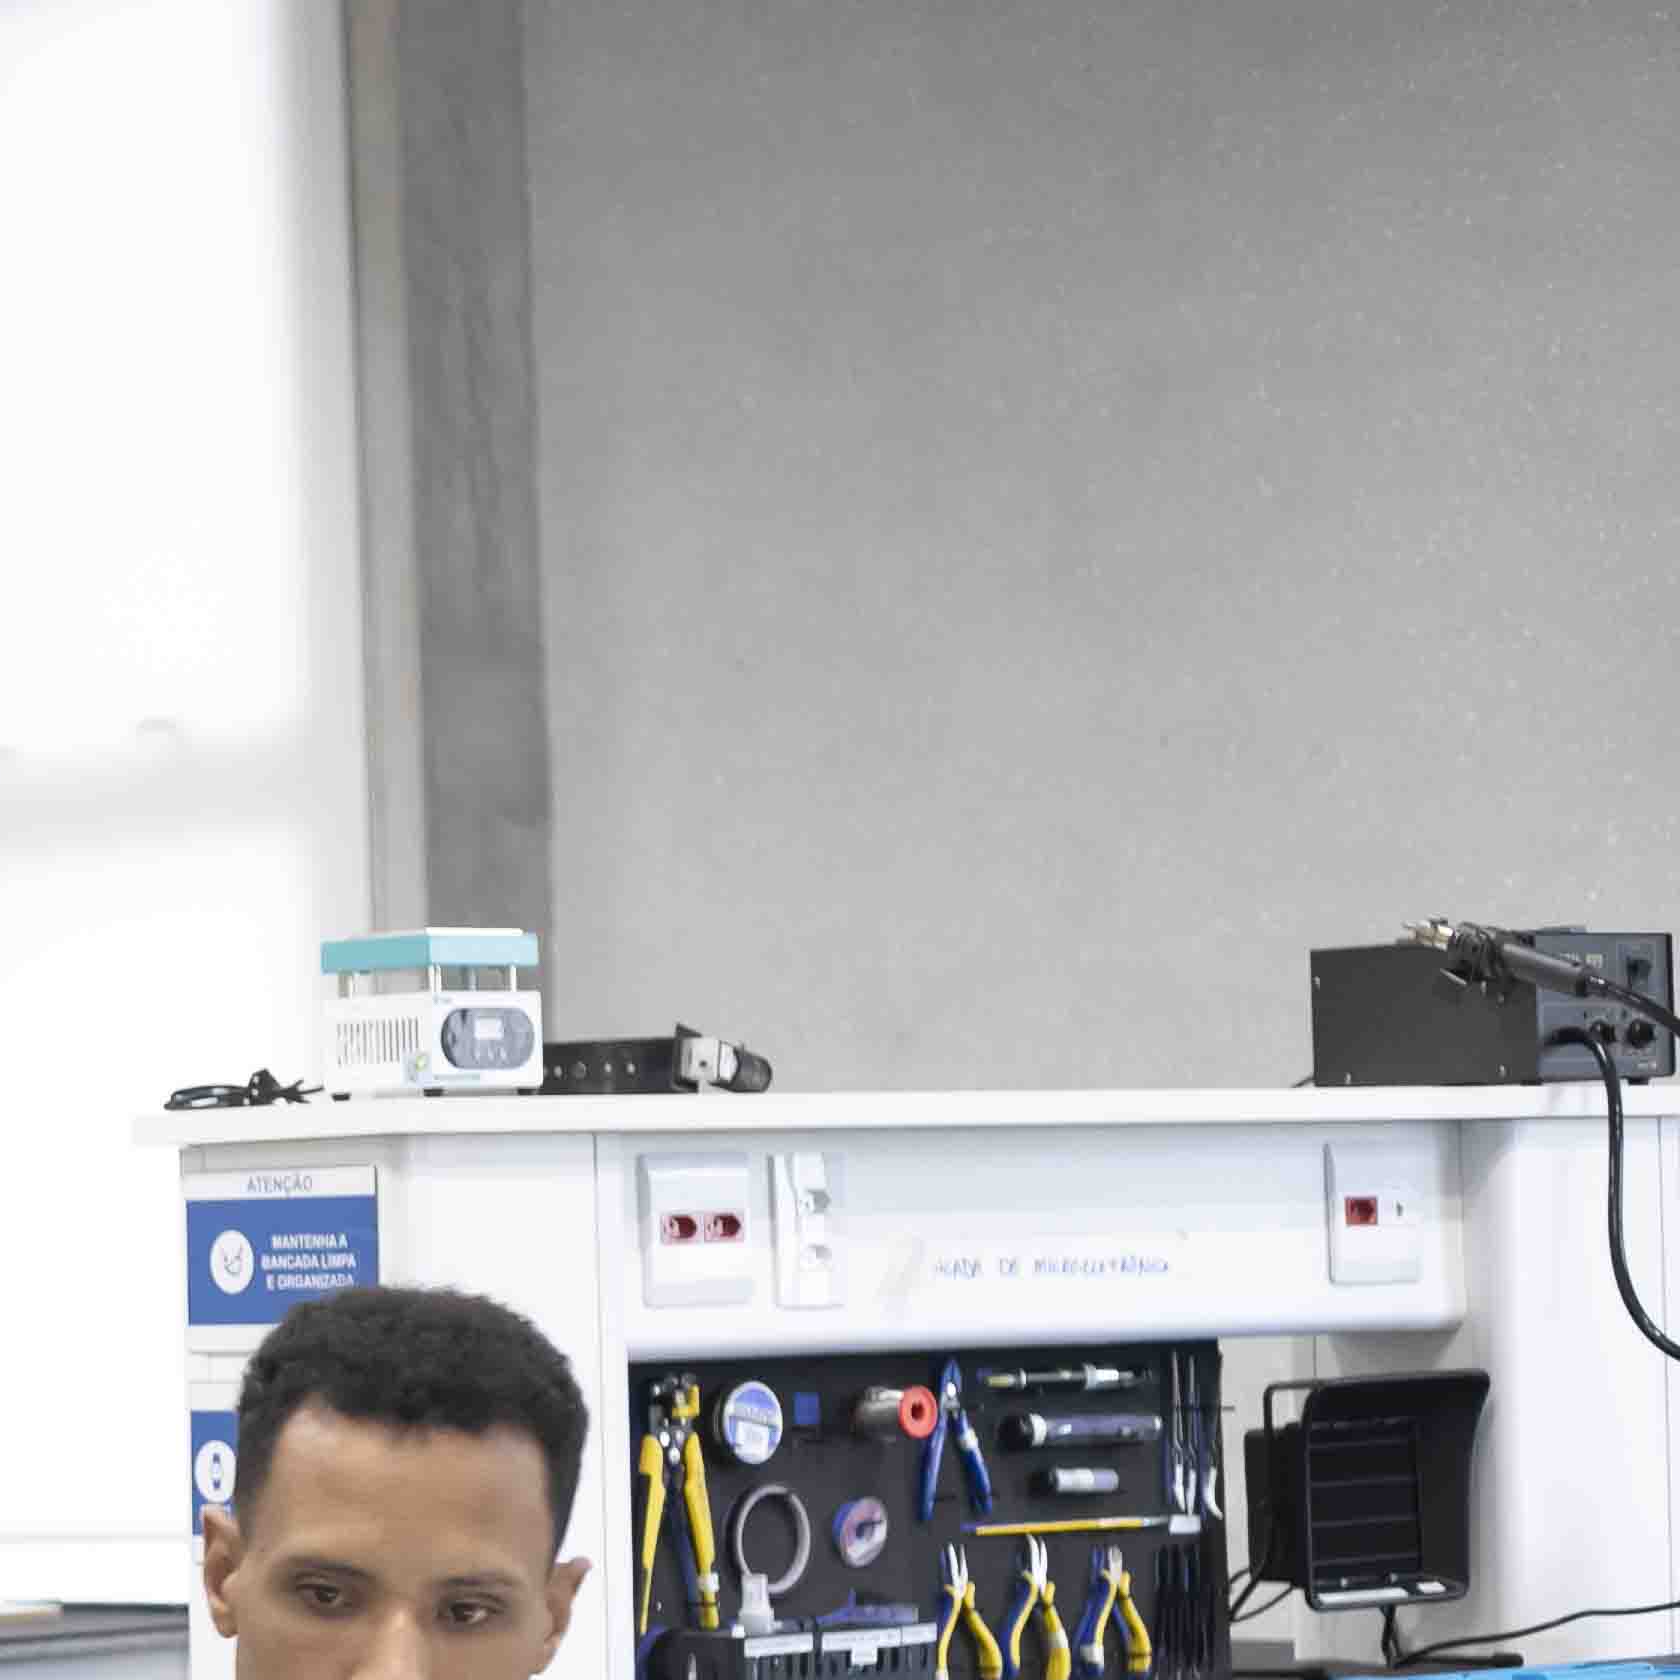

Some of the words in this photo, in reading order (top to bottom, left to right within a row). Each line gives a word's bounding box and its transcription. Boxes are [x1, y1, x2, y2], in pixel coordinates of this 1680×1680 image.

[247, 1173, 313, 1194] ATENÇÃO
[271, 1234, 336, 1249] MANTENHA
[338, 1233, 349, 1248] A
[261, 1254, 320, 1270] BANCADA
[322, 1253, 356, 1269] LIMPA
[265, 1275, 275, 1290] E
[277, 1273, 355, 1290] ORGANIZADA
